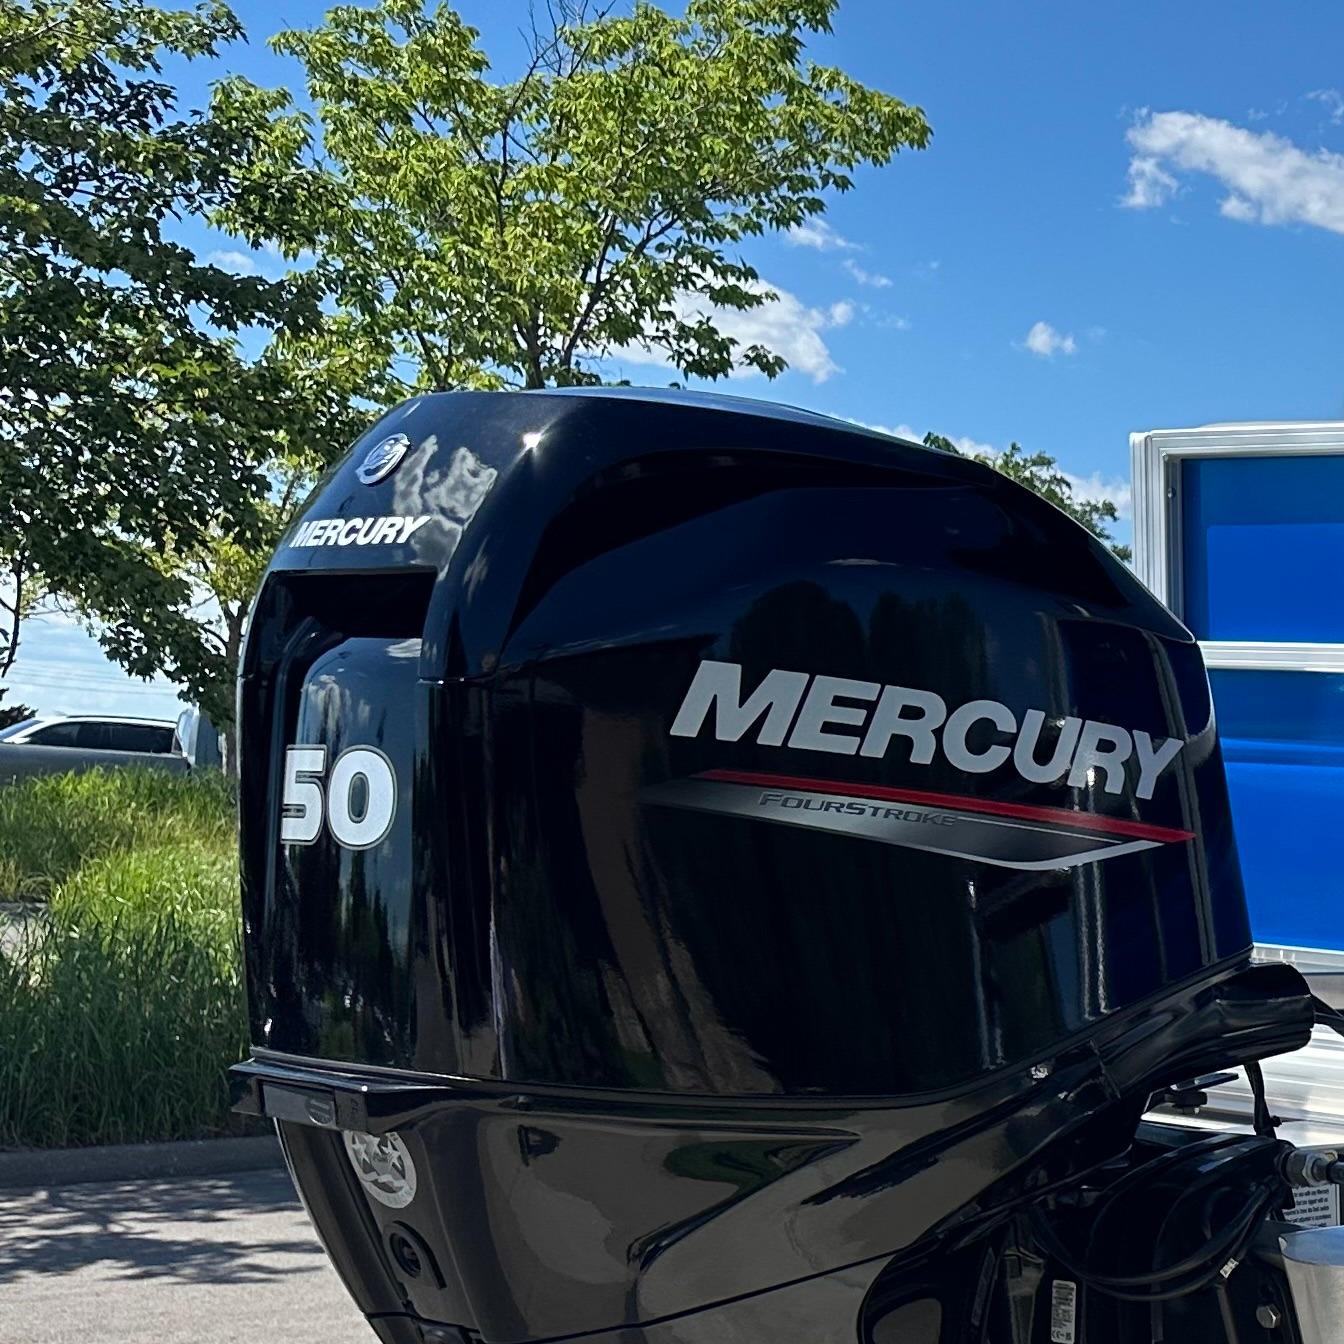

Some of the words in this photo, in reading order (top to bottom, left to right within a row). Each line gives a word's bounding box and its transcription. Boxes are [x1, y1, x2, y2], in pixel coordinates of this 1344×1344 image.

[289, 515, 432, 549] MERCURY
[669, 659, 1185, 801] MERCURY
[280, 744, 398, 851] 50
